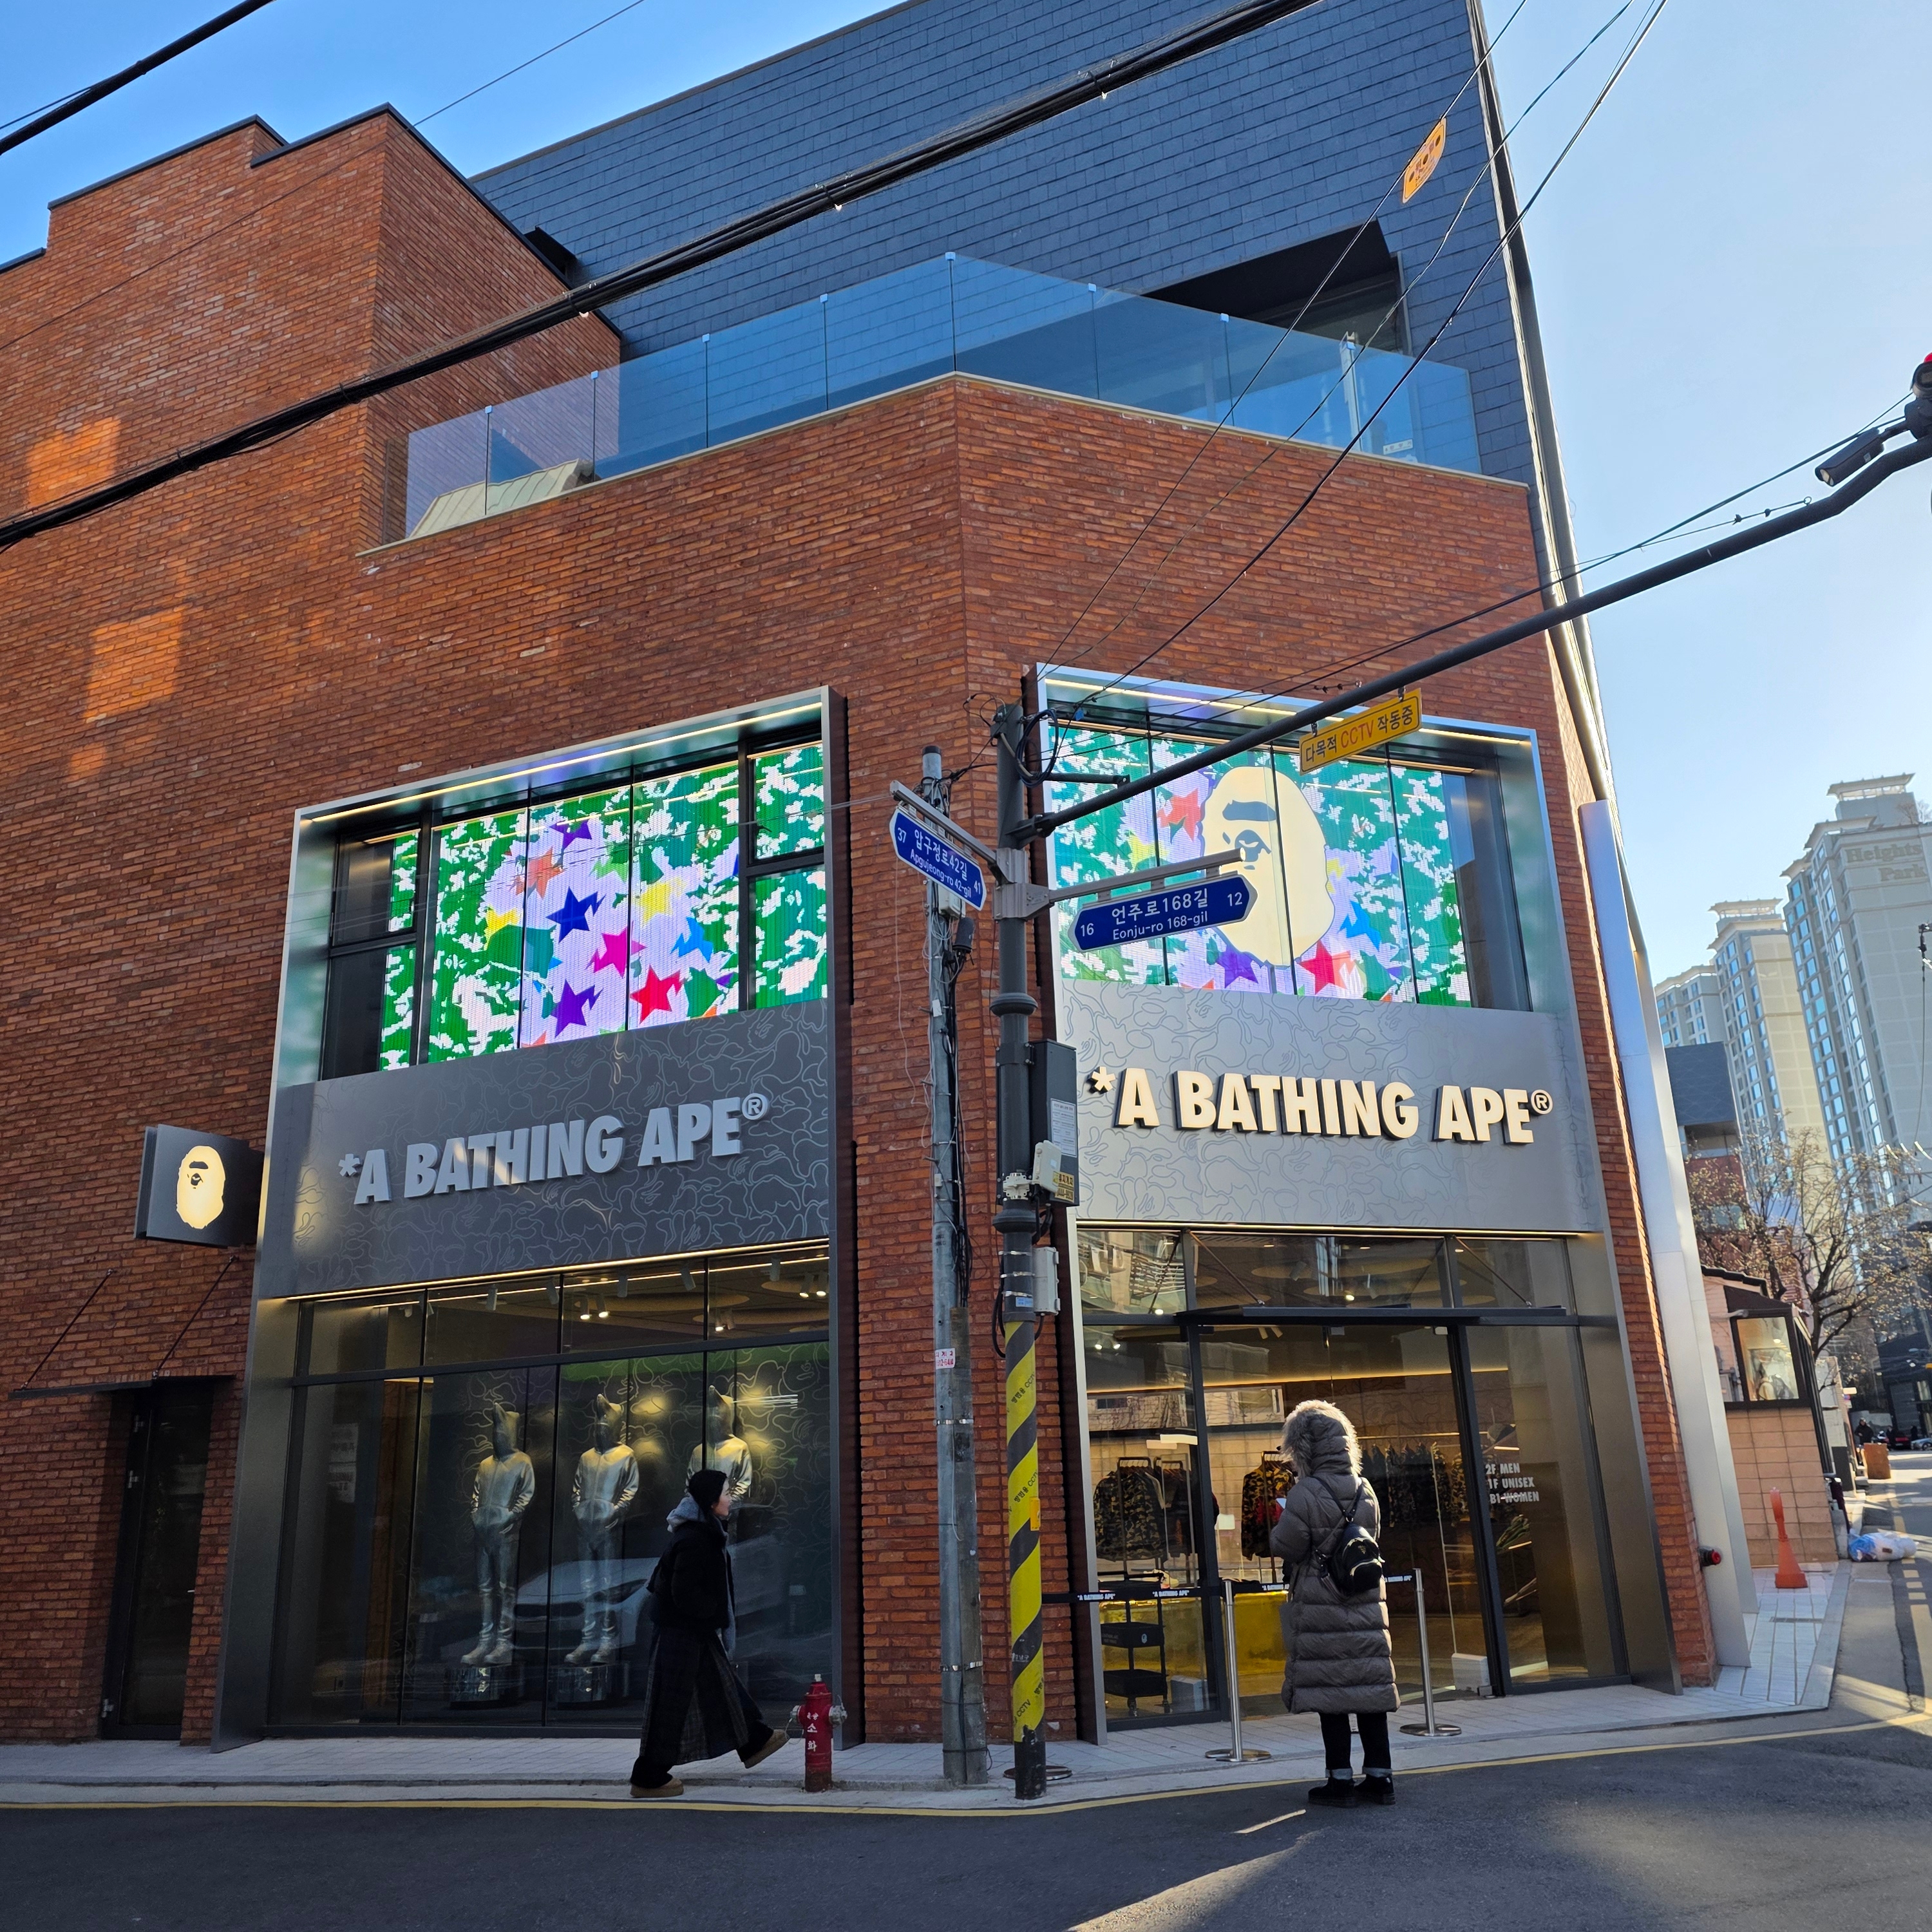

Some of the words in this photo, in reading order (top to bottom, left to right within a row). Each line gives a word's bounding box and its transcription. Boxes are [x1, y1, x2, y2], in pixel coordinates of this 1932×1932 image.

[1305, 734, 1338, 762] 다목적
[1340, 719, 1374, 748] CCTV
[1377, 705, 1414, 734] 작동중
[897, 827, 907, 844] 37
[914, 829, 967, 881] 압구정로42길
[1844, 842, 1922, 863] Heights
[910, 848, 954, 886] Apgujeong-ro
[954, 879, 971, 898] 42-gil
[1878, 864, 1928, 882] Park
[973, 880, 981, 895] 41
[1112, 888, 1208, 925] 언주로168길
[1227, 891, 1243, 907] 12
[1080, 922, 1094, 937] 16
[1113, 922, 1163, 941] Eonju-ro
[1167, 911, 1208, 931] 168-gil
[1172, 1070, 1419, 1140] BATHING
[403, 1115, 625, 1199] BATHING
[1485, 1463, 1496, 1475] 2F
[1500, 1463, 1520, 1474] MEN
[1488, 1478, 1499, 1489] 1F
[1502, 1477, 1535, 1489] UNISEX
[1490, 1493, 1501, 1504] B1
[1503, 1491, 1540, 1504] WOMEN
[1016, 1698, 1031, 1718] CCTV
